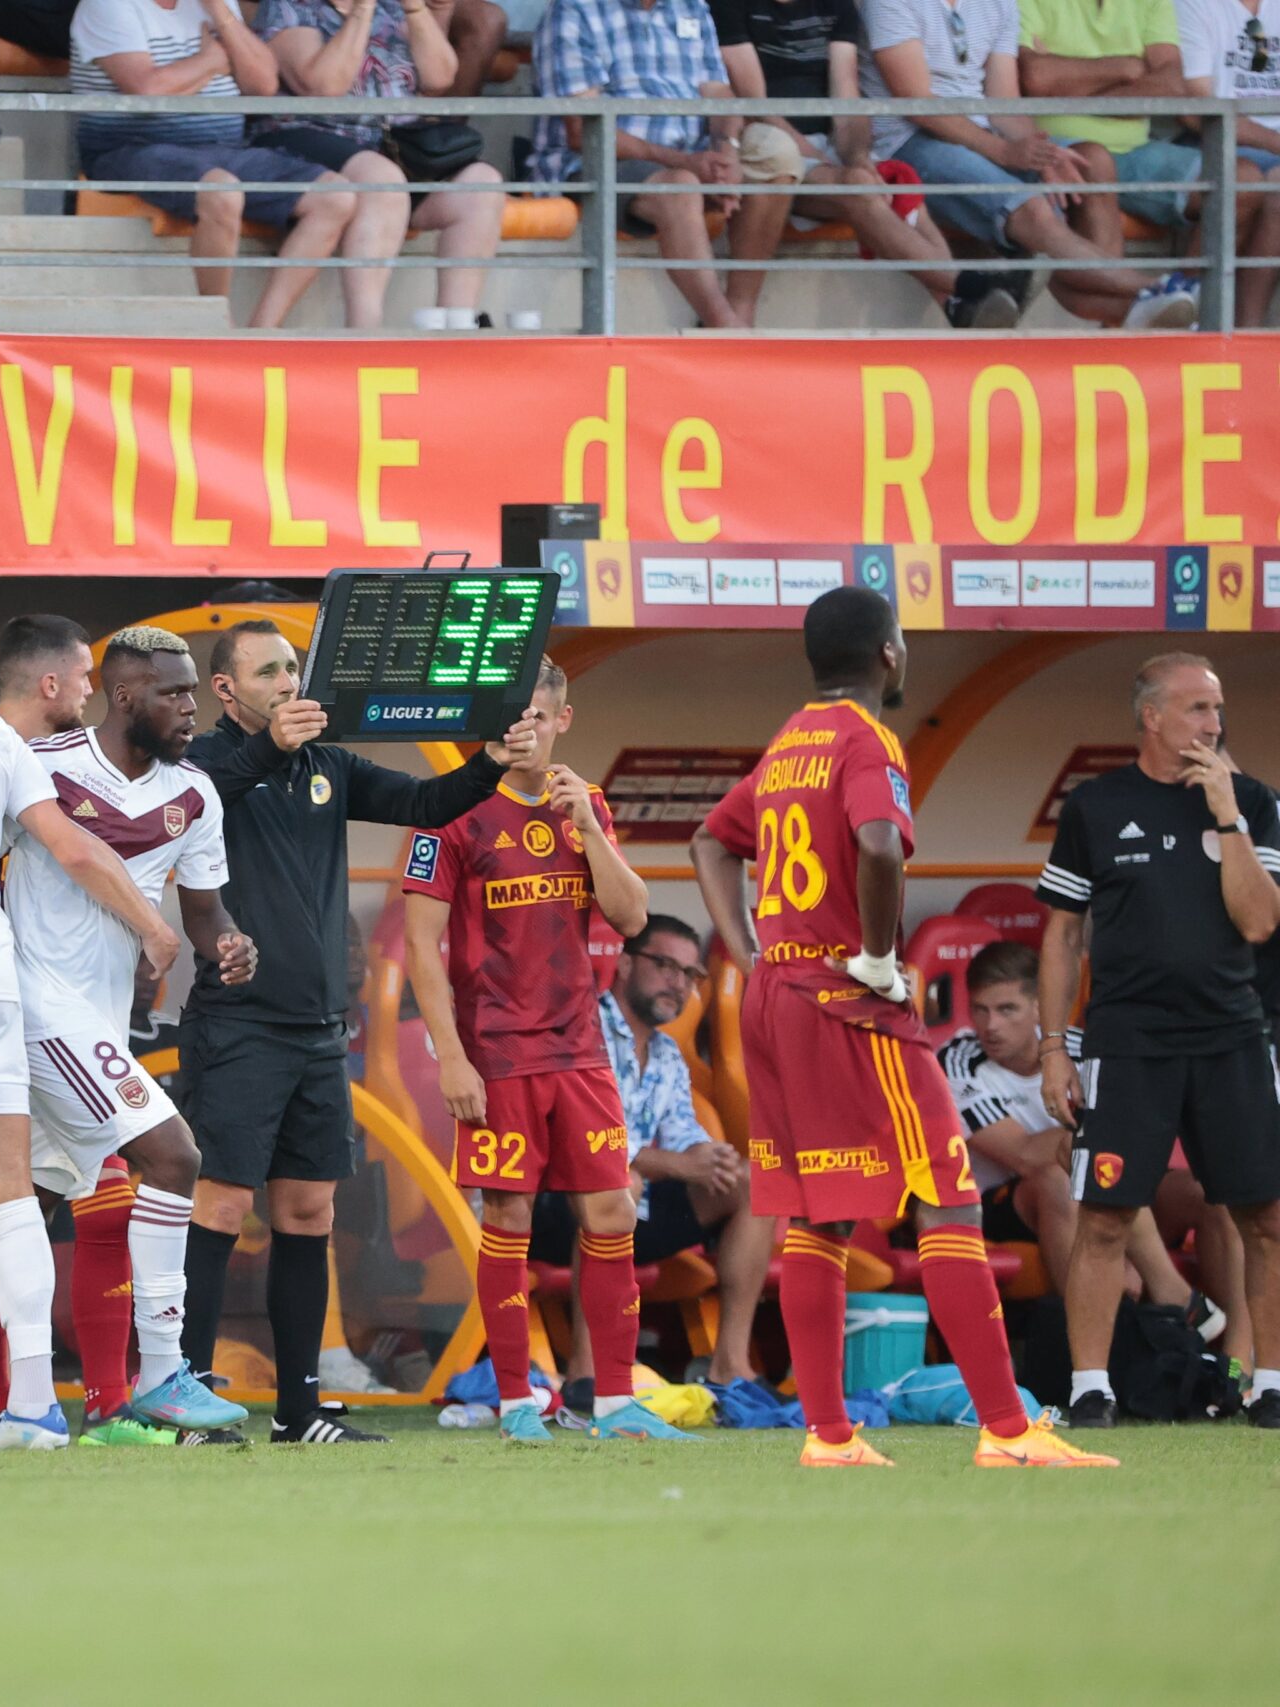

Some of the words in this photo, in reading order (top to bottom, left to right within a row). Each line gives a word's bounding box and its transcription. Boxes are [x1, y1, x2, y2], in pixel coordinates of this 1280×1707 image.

[0, 364, 422, 546] VILLE
[562, 365, 723, 546] de
[860, 363, 1244, 545] RODE
[429, 580, 543, 685] 32
[383, 706, 423, 719] LIGUE
[424, 706, 434, 719] 2
[436, 707, 464, 719] BKT
[758, 803, 828, 920] 28
[490, 877, 588, 905] MAXOUTIL
[94, 1041, 131, 1080] 8
[470, 1128, 527, 1180] 32
[948, 1135, 977, 1192] 2
